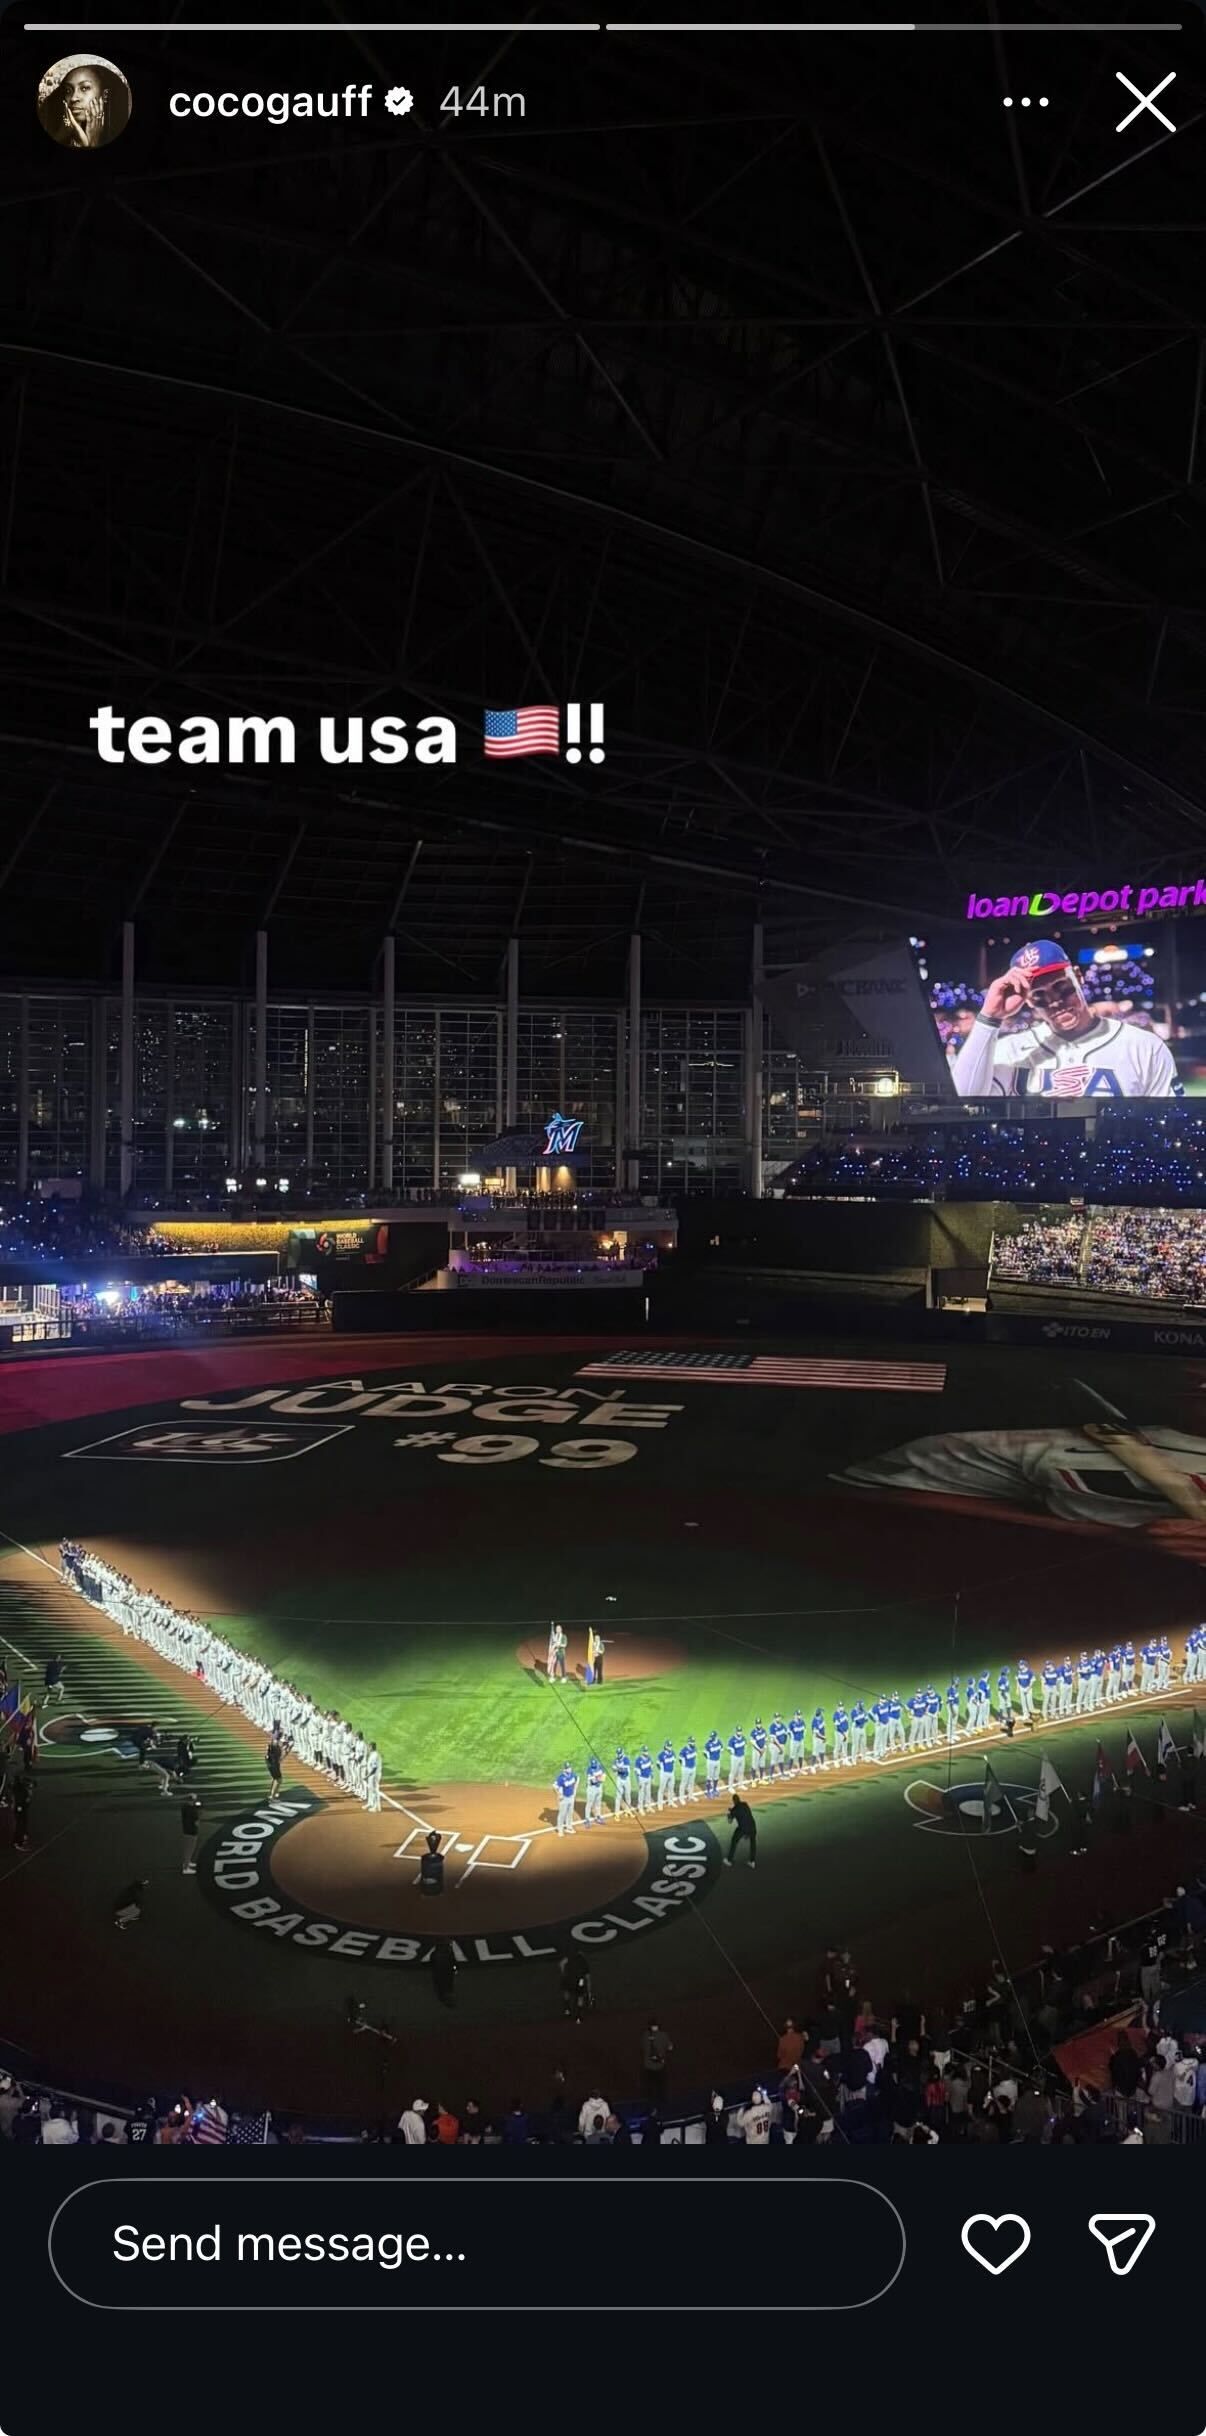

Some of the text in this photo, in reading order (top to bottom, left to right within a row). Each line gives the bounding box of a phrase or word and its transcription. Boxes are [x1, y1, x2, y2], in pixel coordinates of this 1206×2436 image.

[968, 879, 1206, 918] loanDepot park
[1014, 1066, 1122, 1095] USA
[180, 1390, 684, 1428] JUDGE
[306, 1380, 626, 1400] AARON
[393, 1431, 638, 1469] #99
[213, 1800, 311, 1890] WORLD
[571, 1835, 706, 1945] CLASSIC
[132, 2128, 147, 2141] 27
